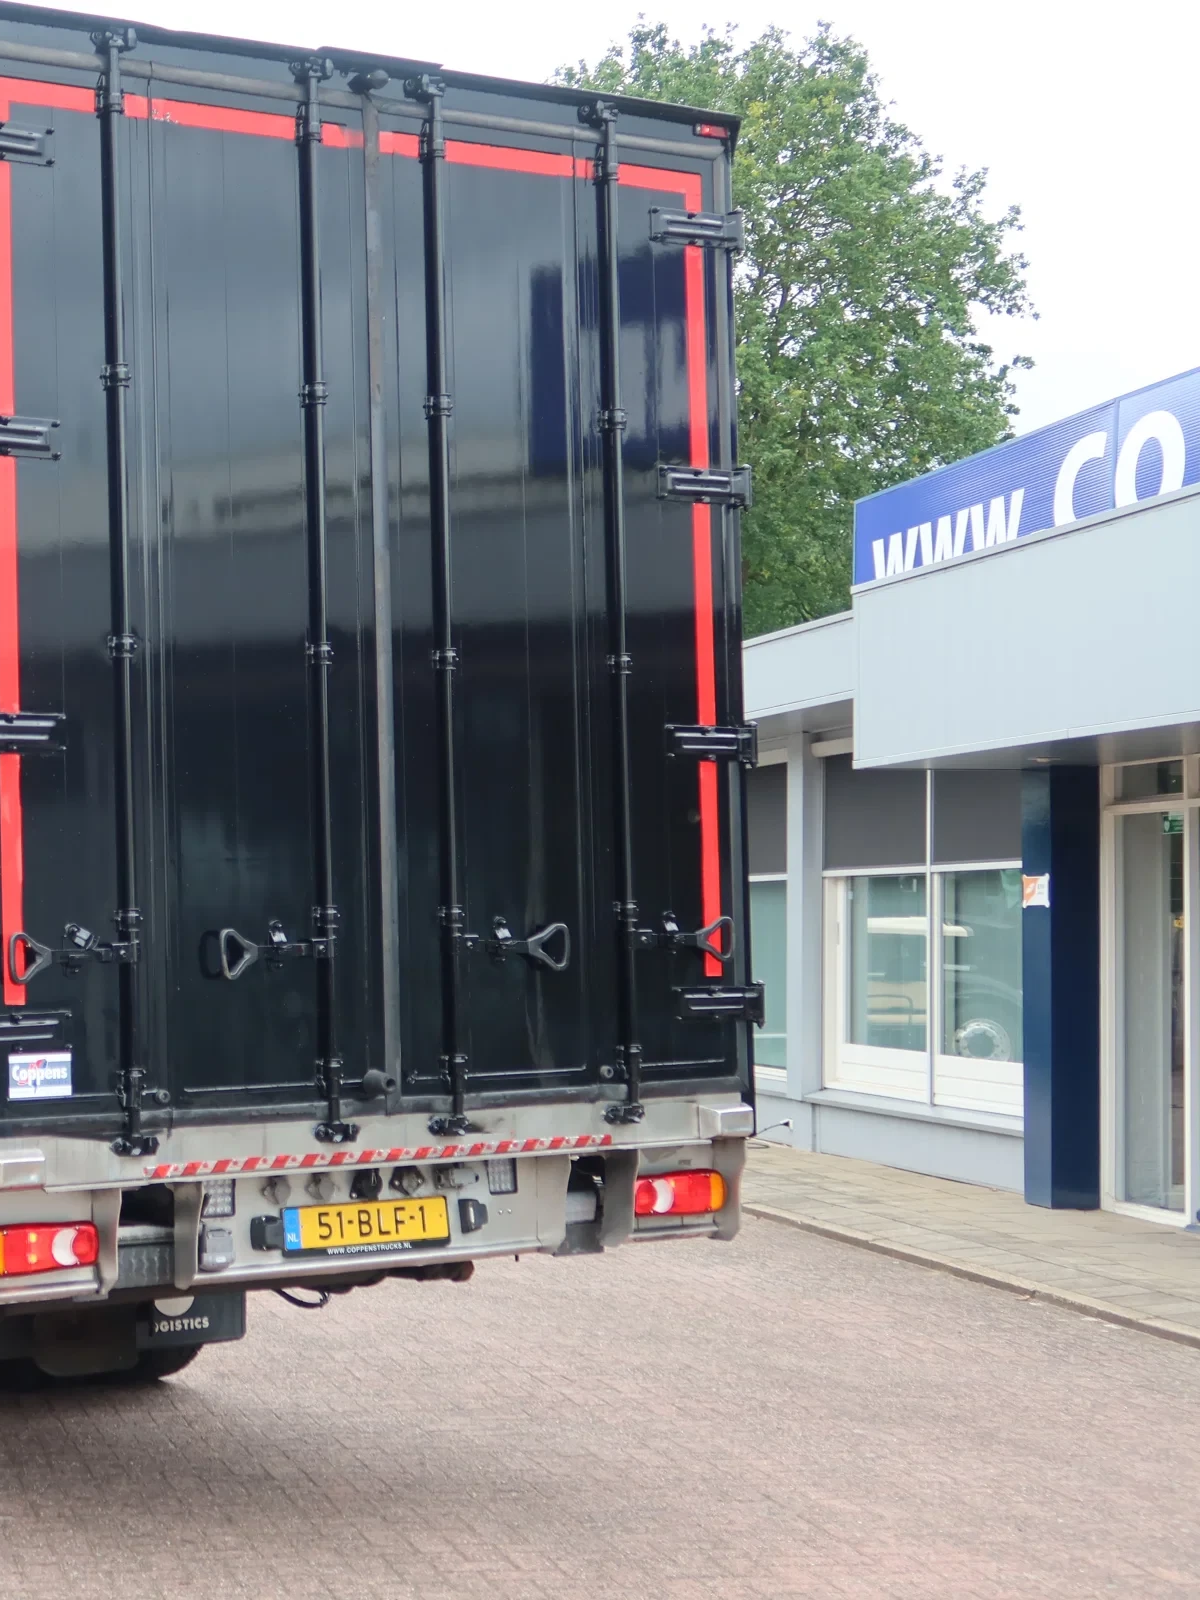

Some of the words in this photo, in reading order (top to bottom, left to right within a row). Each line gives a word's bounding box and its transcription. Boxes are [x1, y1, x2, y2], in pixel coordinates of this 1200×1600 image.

[11, 1064, 68, 1087] Coppens
[317, 1205, 427, 1240] 51-BLF-1
[287, 1233, 299, 1242] NL
[327, 1242, 412, 1255] WWW.COPPENSTRUCKS.NL
[154, 1316, 210, 1332] GISTICS
